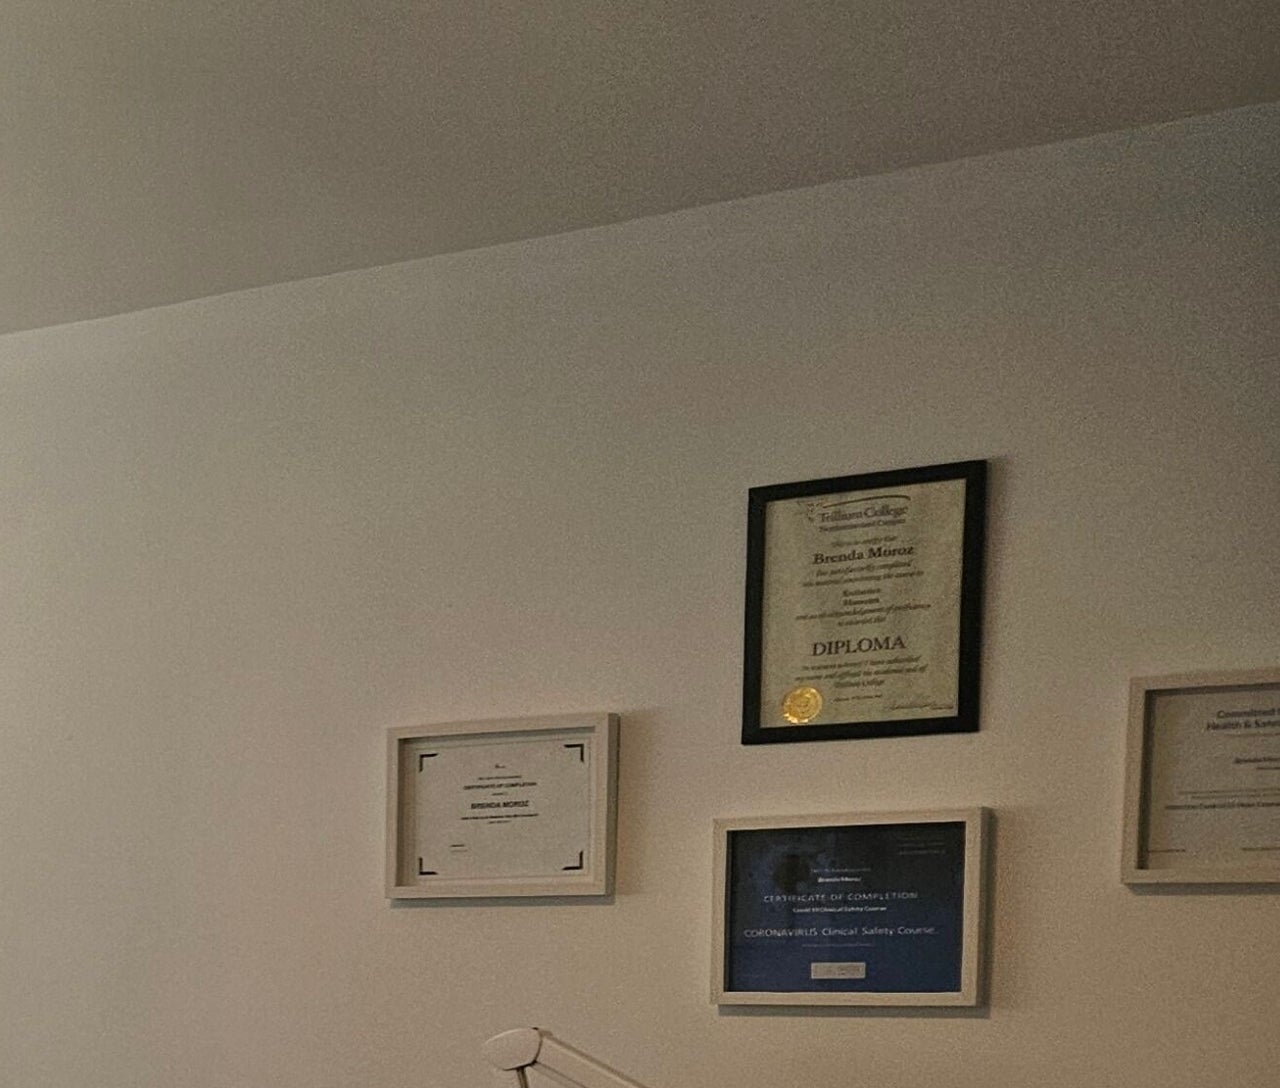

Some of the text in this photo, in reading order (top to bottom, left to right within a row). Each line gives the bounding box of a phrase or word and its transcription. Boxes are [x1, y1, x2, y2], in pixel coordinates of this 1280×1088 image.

[812, 546, 915, 564] Brenda Moroz
[811, 635, 907, 657] DIPLOMA
[763, 894, 826, 903] CERTIFICATE
[847, 891, 919, 901] COMPLETION
[743, 927, 819, 938] CORONAVIRUS
[821, 926, 858, 937] Clinical
[861, 926, 894, 938] Safety
